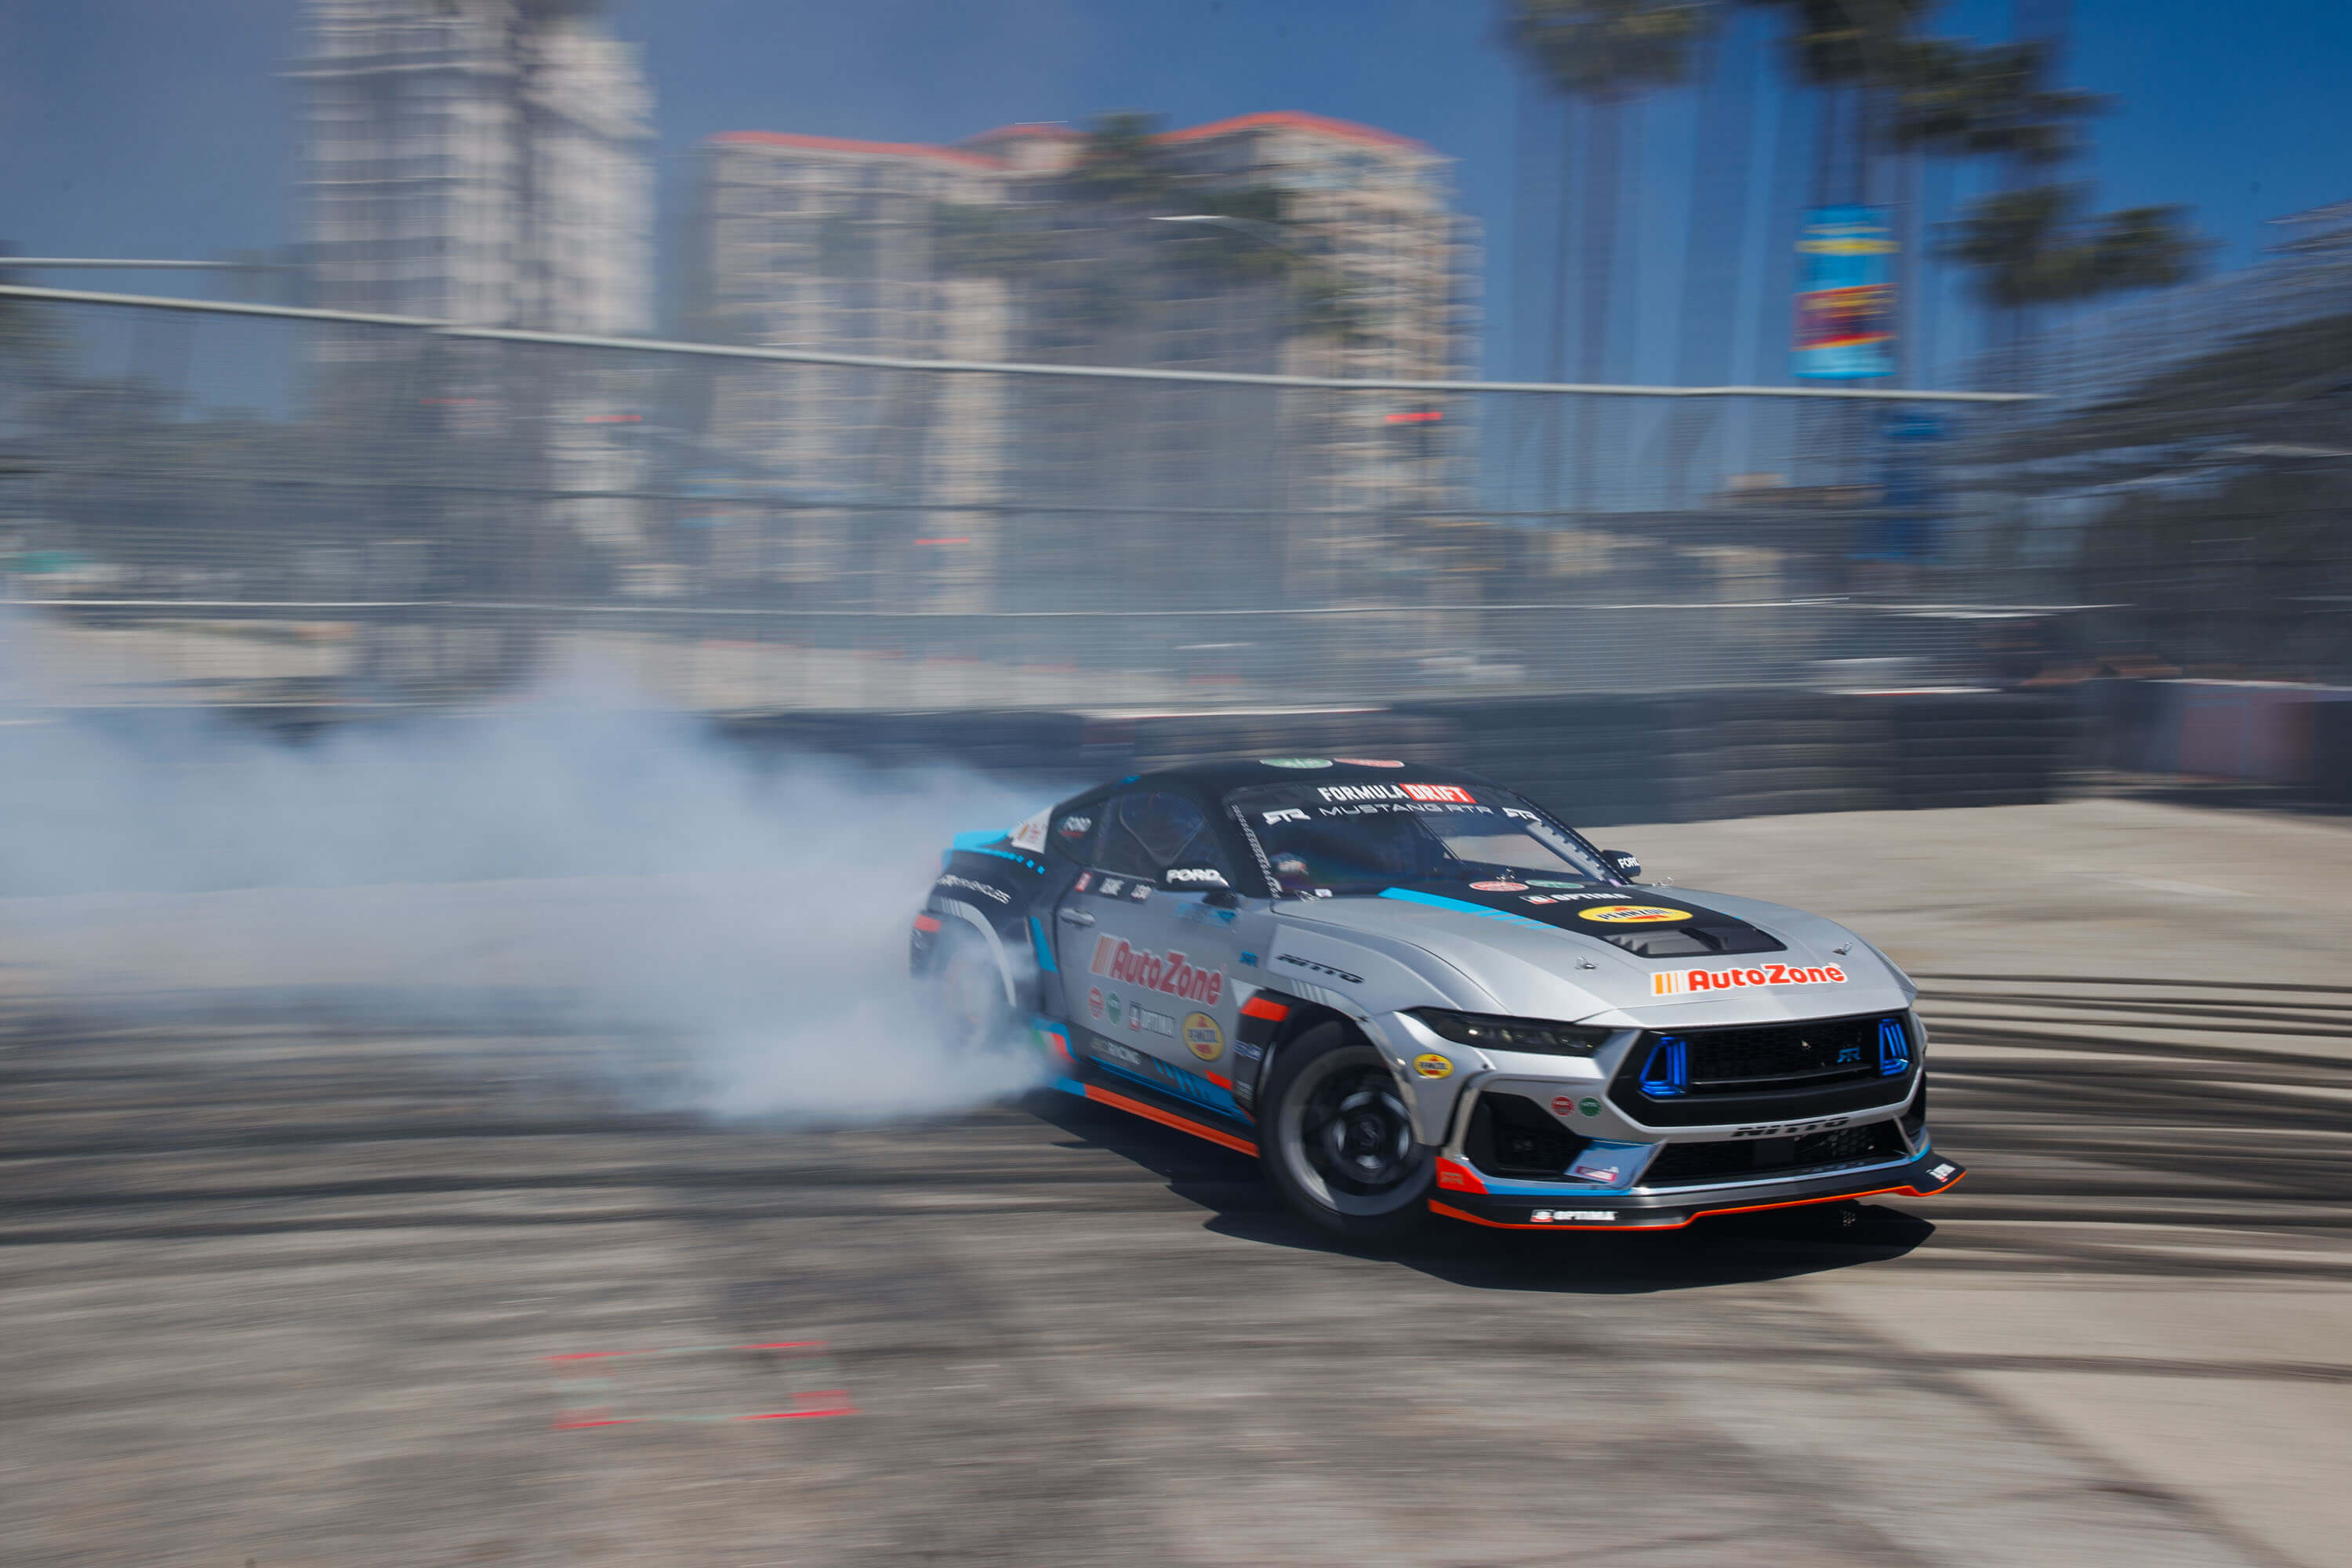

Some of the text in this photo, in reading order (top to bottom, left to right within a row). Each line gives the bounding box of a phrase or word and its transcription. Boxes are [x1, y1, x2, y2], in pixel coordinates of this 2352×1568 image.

[1317, 785, 1470, 803] FORMULA DRIFT
[1319, 803, 1494, 817] MUSTANG RTR
[1166, 868, 1221, 884] FORD
[1109, 940, 1223, 1005] AutoZone
[1688, 964, 1845, 992] AutoZone
[1731, 1116, 1851, 1137] NITTO
